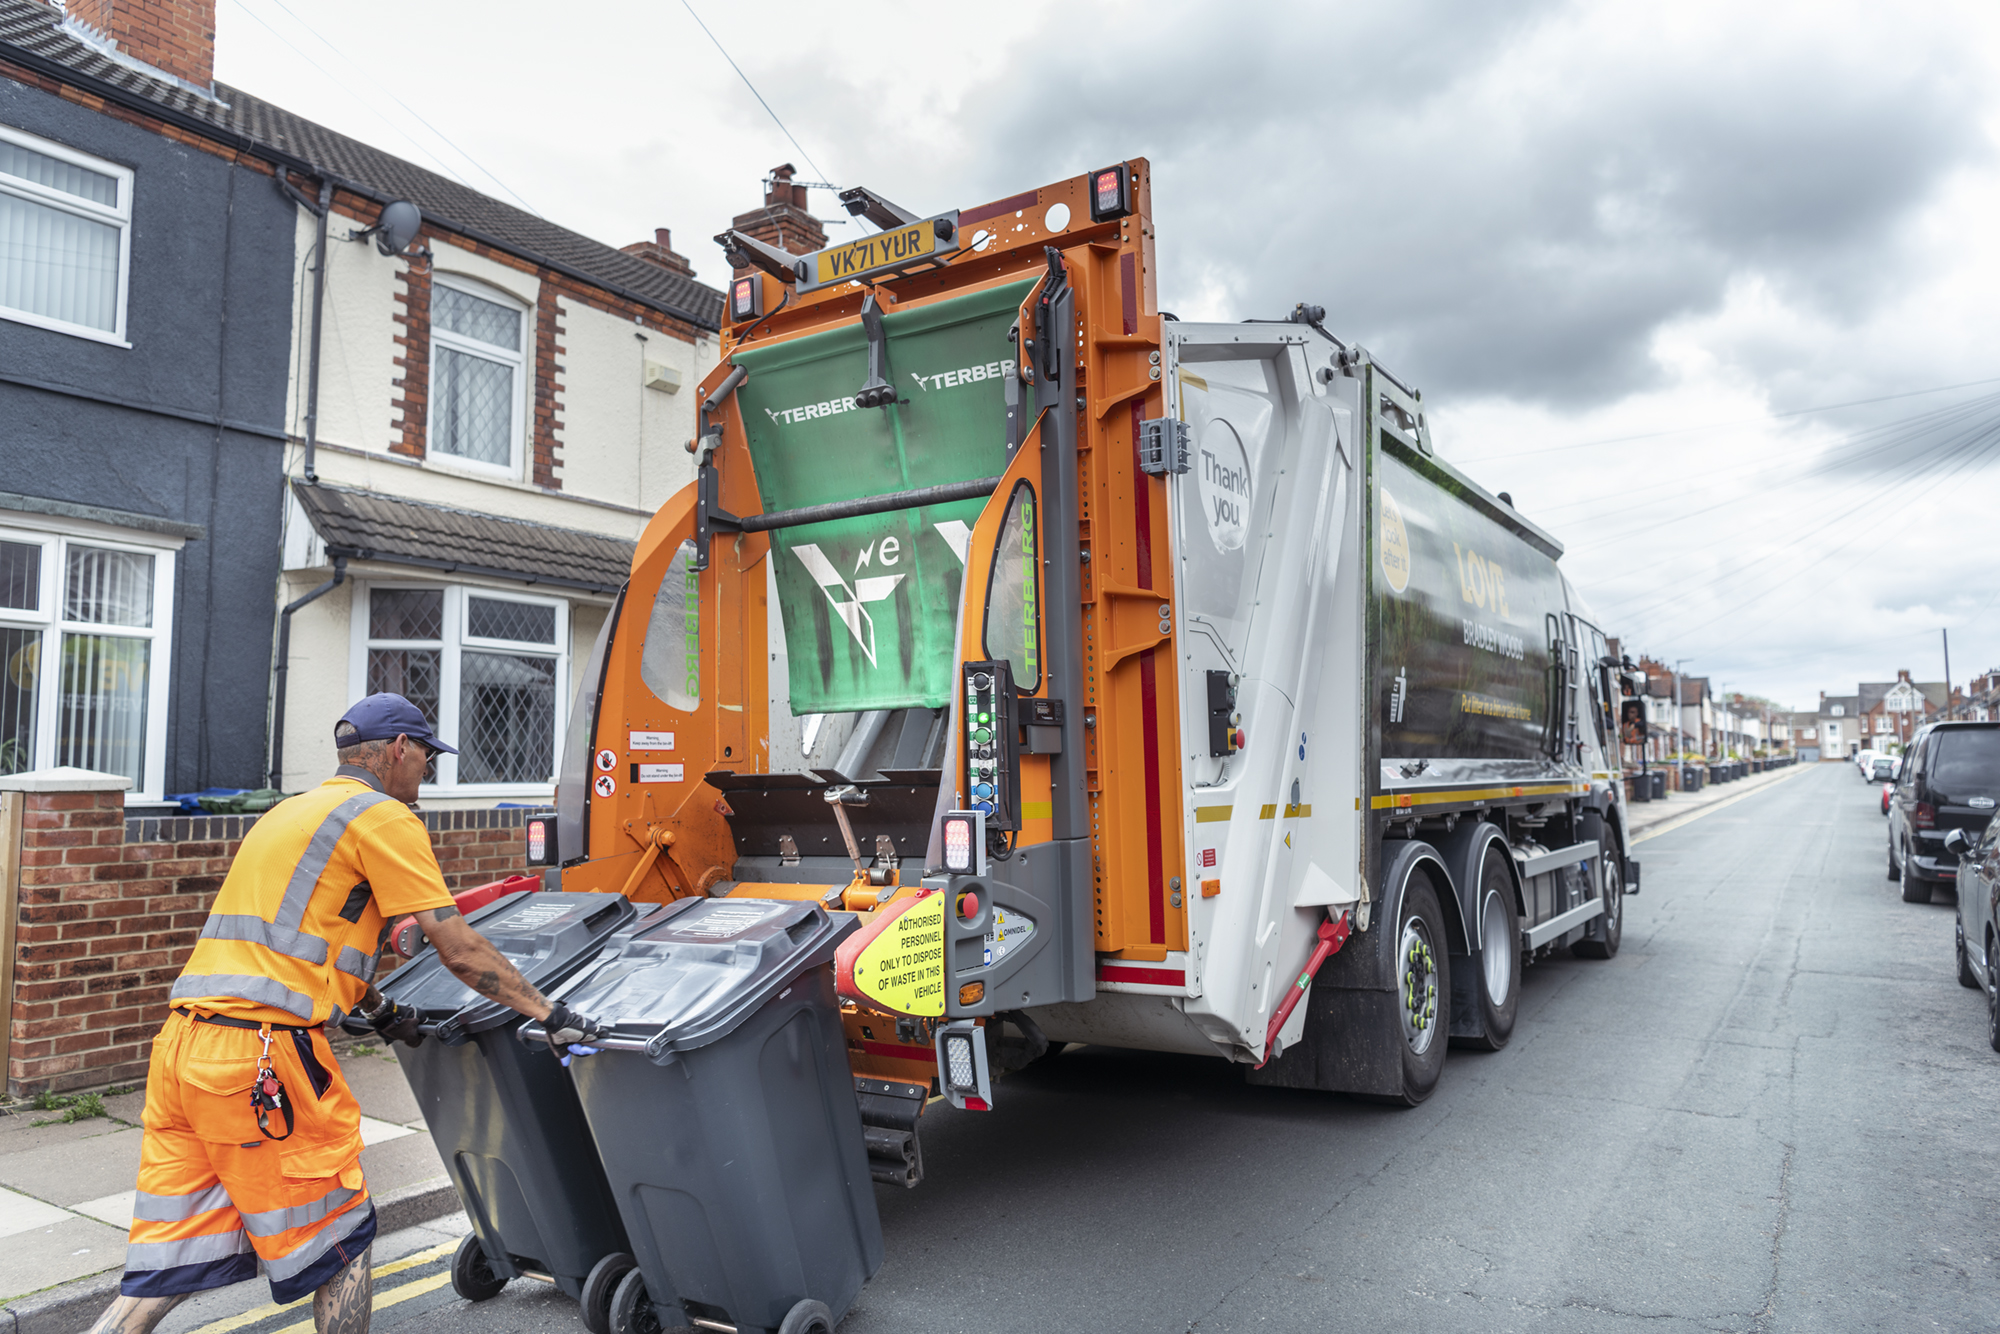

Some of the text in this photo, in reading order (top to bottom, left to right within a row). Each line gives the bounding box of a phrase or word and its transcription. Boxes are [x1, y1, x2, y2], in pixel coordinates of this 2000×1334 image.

[830, 229, 921, 276] VK71 YUR
[930, 359, 1016, 390] TERBER
[780, 396, 858, 425] TERBER
[1201, 449, 1248, 499] Thank
[1213, 494, 1240, 527] you
[1021, 503, 1037, 674] TERBERG
[1453, 541, 1510, 619] LOVE
[1463, 618, 1497, 653] BRADLEY
[898, 914, 941, 932] AUTHORISED
[901, 931, 941, 949] PERSONNEL
[880, 947, 941, 972] ONLY TO DISPOSE
[878, 965, 940, 991] OF WASTE IN THIS
[914, 981, 941, 999] VEHICLE
